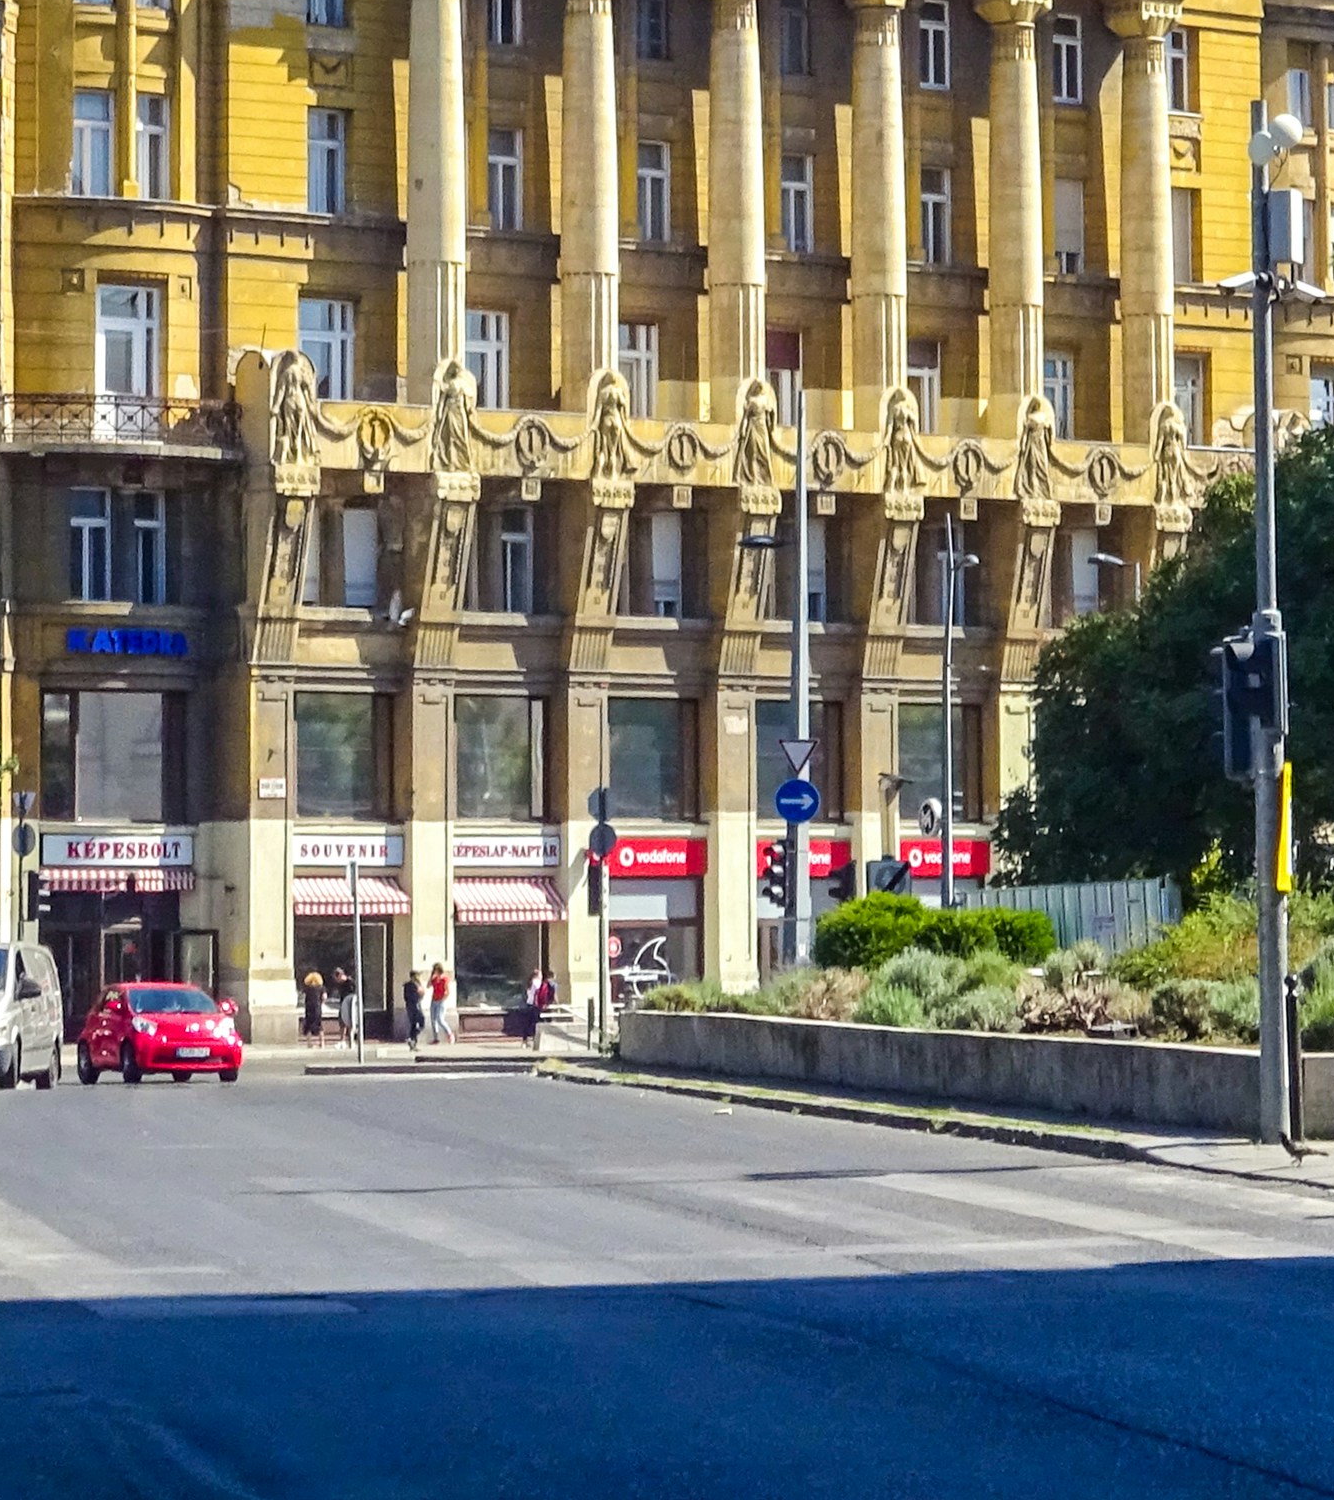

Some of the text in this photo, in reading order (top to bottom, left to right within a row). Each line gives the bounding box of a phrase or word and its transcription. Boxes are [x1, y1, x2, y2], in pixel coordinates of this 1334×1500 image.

[67, 837, 181, 859] KÉPESBOLT
[300, 844, 389, 858] SOUVENIR
[636, 849, 687, 864] vodafone
